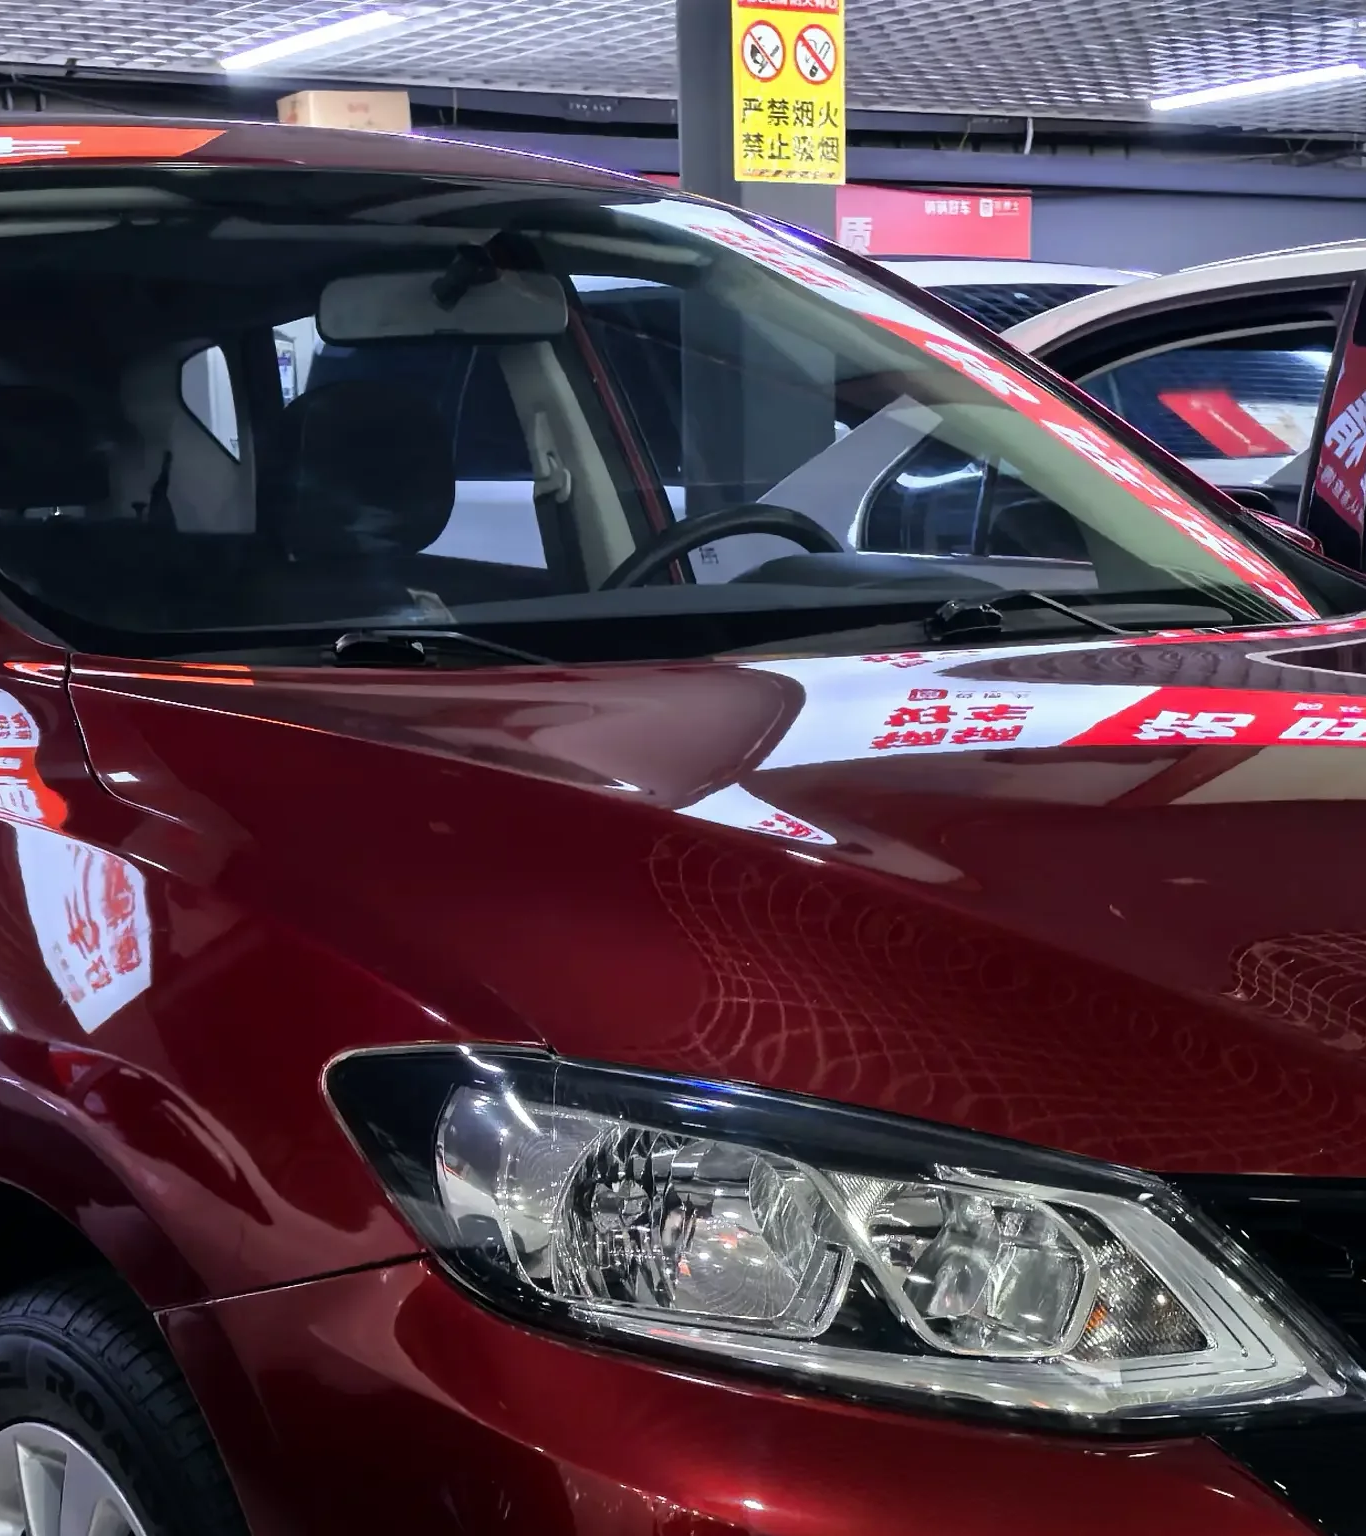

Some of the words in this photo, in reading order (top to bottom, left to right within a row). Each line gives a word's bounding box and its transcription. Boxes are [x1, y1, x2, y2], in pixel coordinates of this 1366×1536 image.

[741, 97, 839, 129] 严禁烟火
[741, 132, 840, 163] 禁止吸烟
